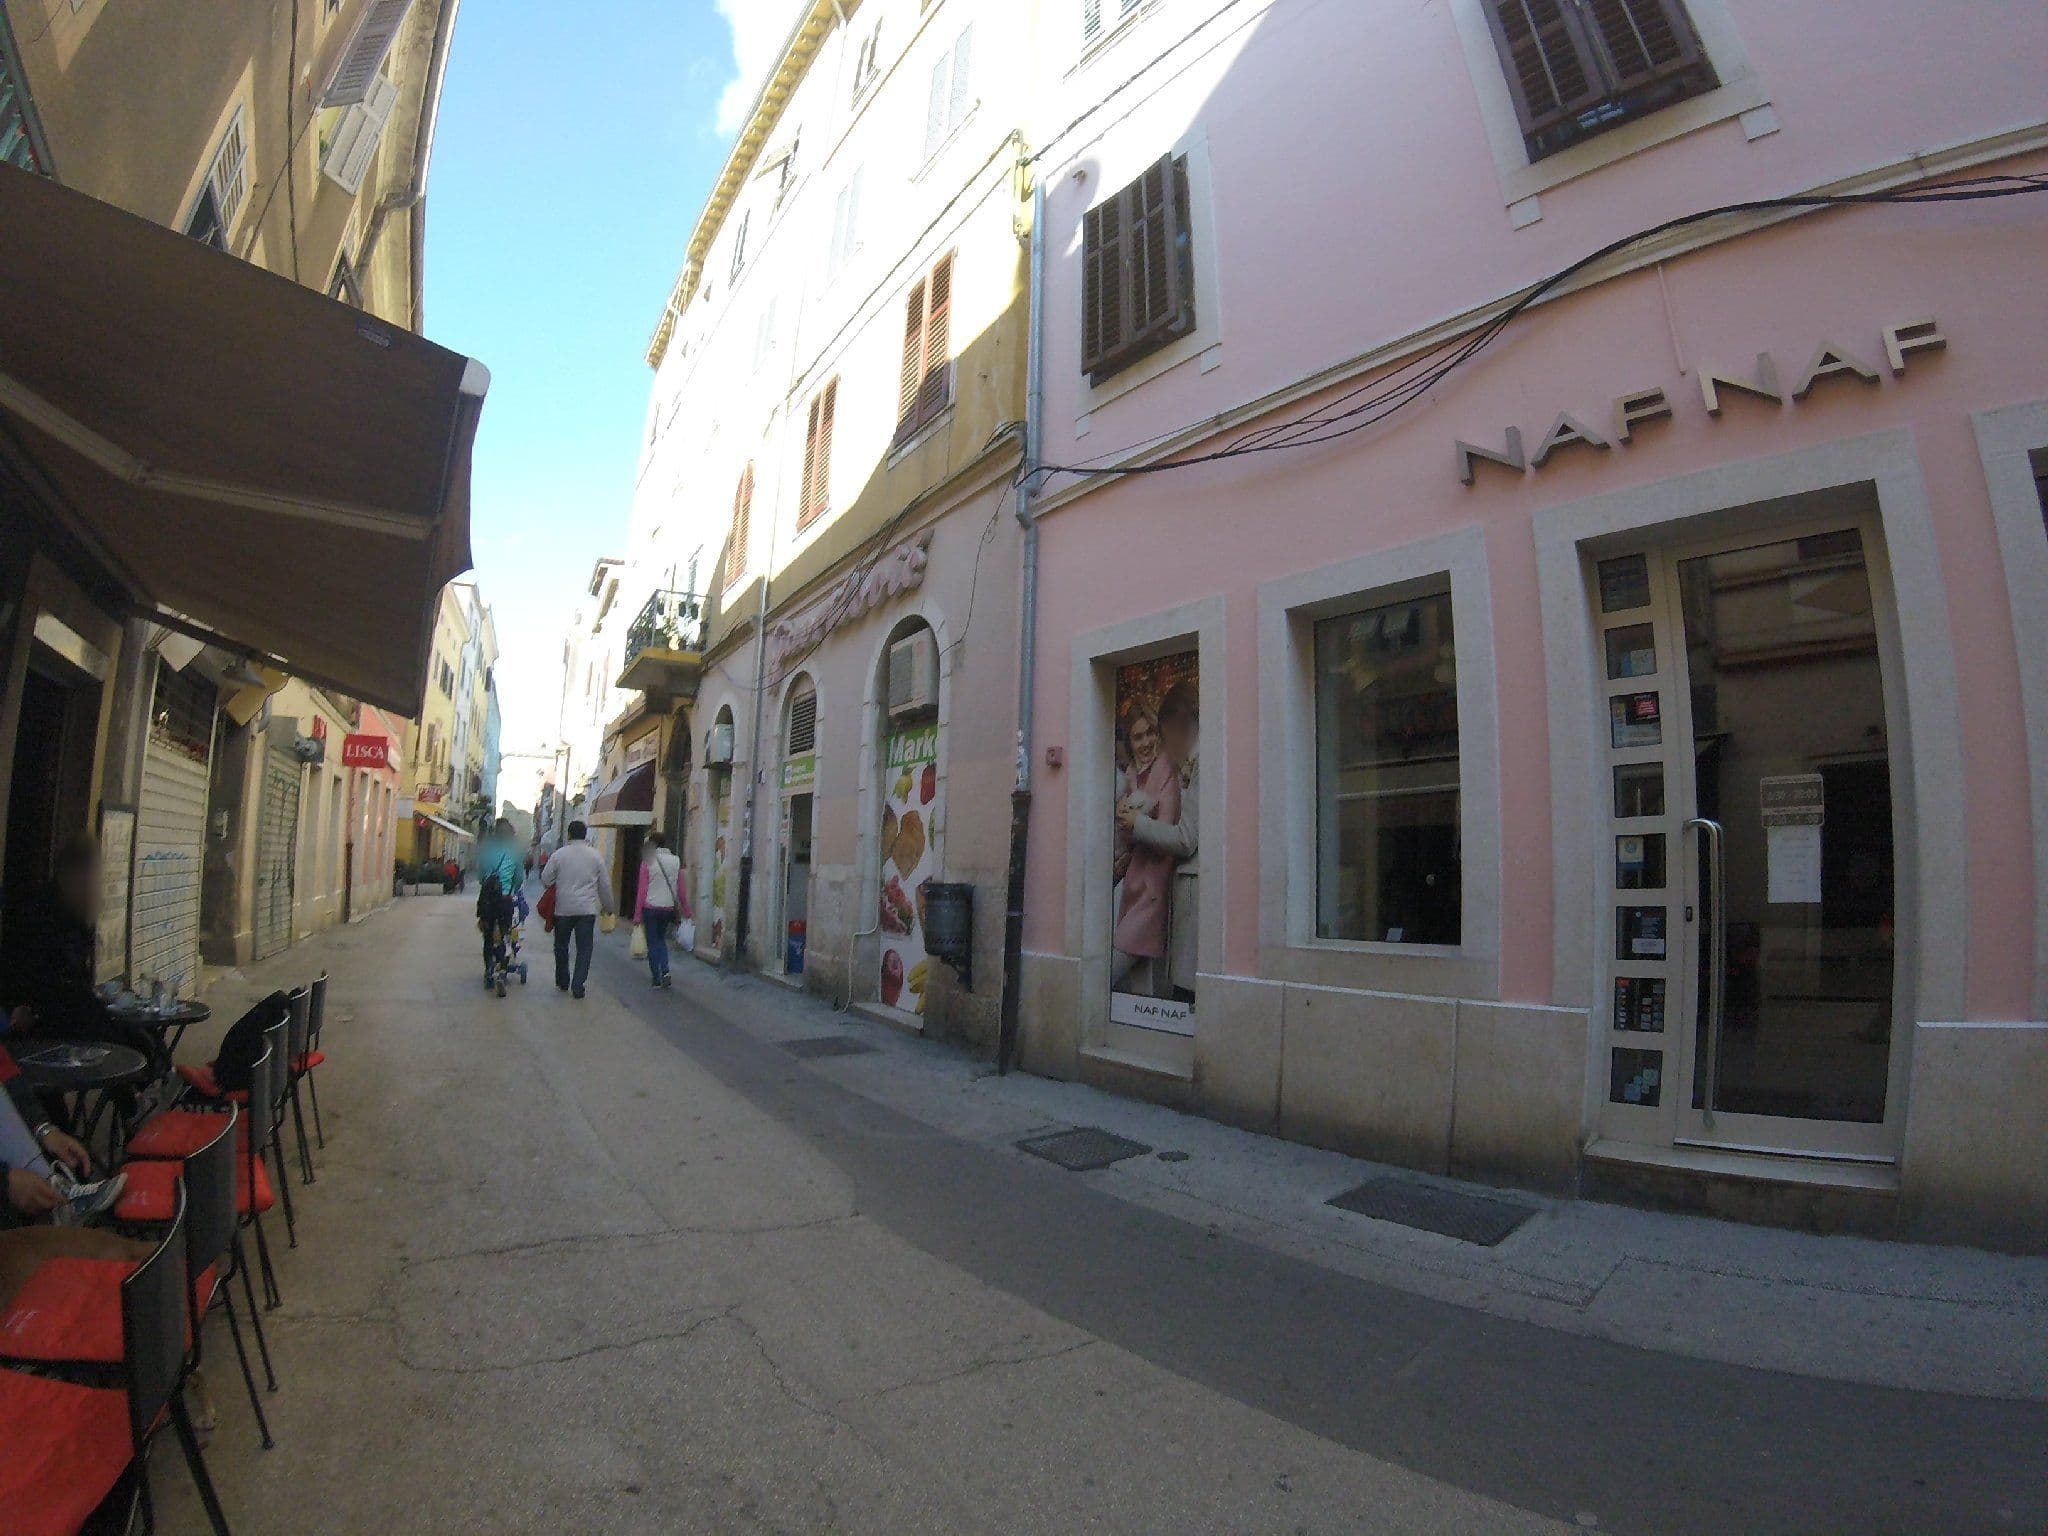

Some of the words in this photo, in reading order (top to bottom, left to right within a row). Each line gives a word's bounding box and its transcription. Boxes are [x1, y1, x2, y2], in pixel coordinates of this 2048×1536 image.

[1455, 386, 1673, 487] NAF
[1697, 317, 1948, 416] NAF
[346, 743, 384, 759] LISCA
[1134, 1004, 1159, 1016] NAF
[1161, 1008, 1187, 1020] NAF
